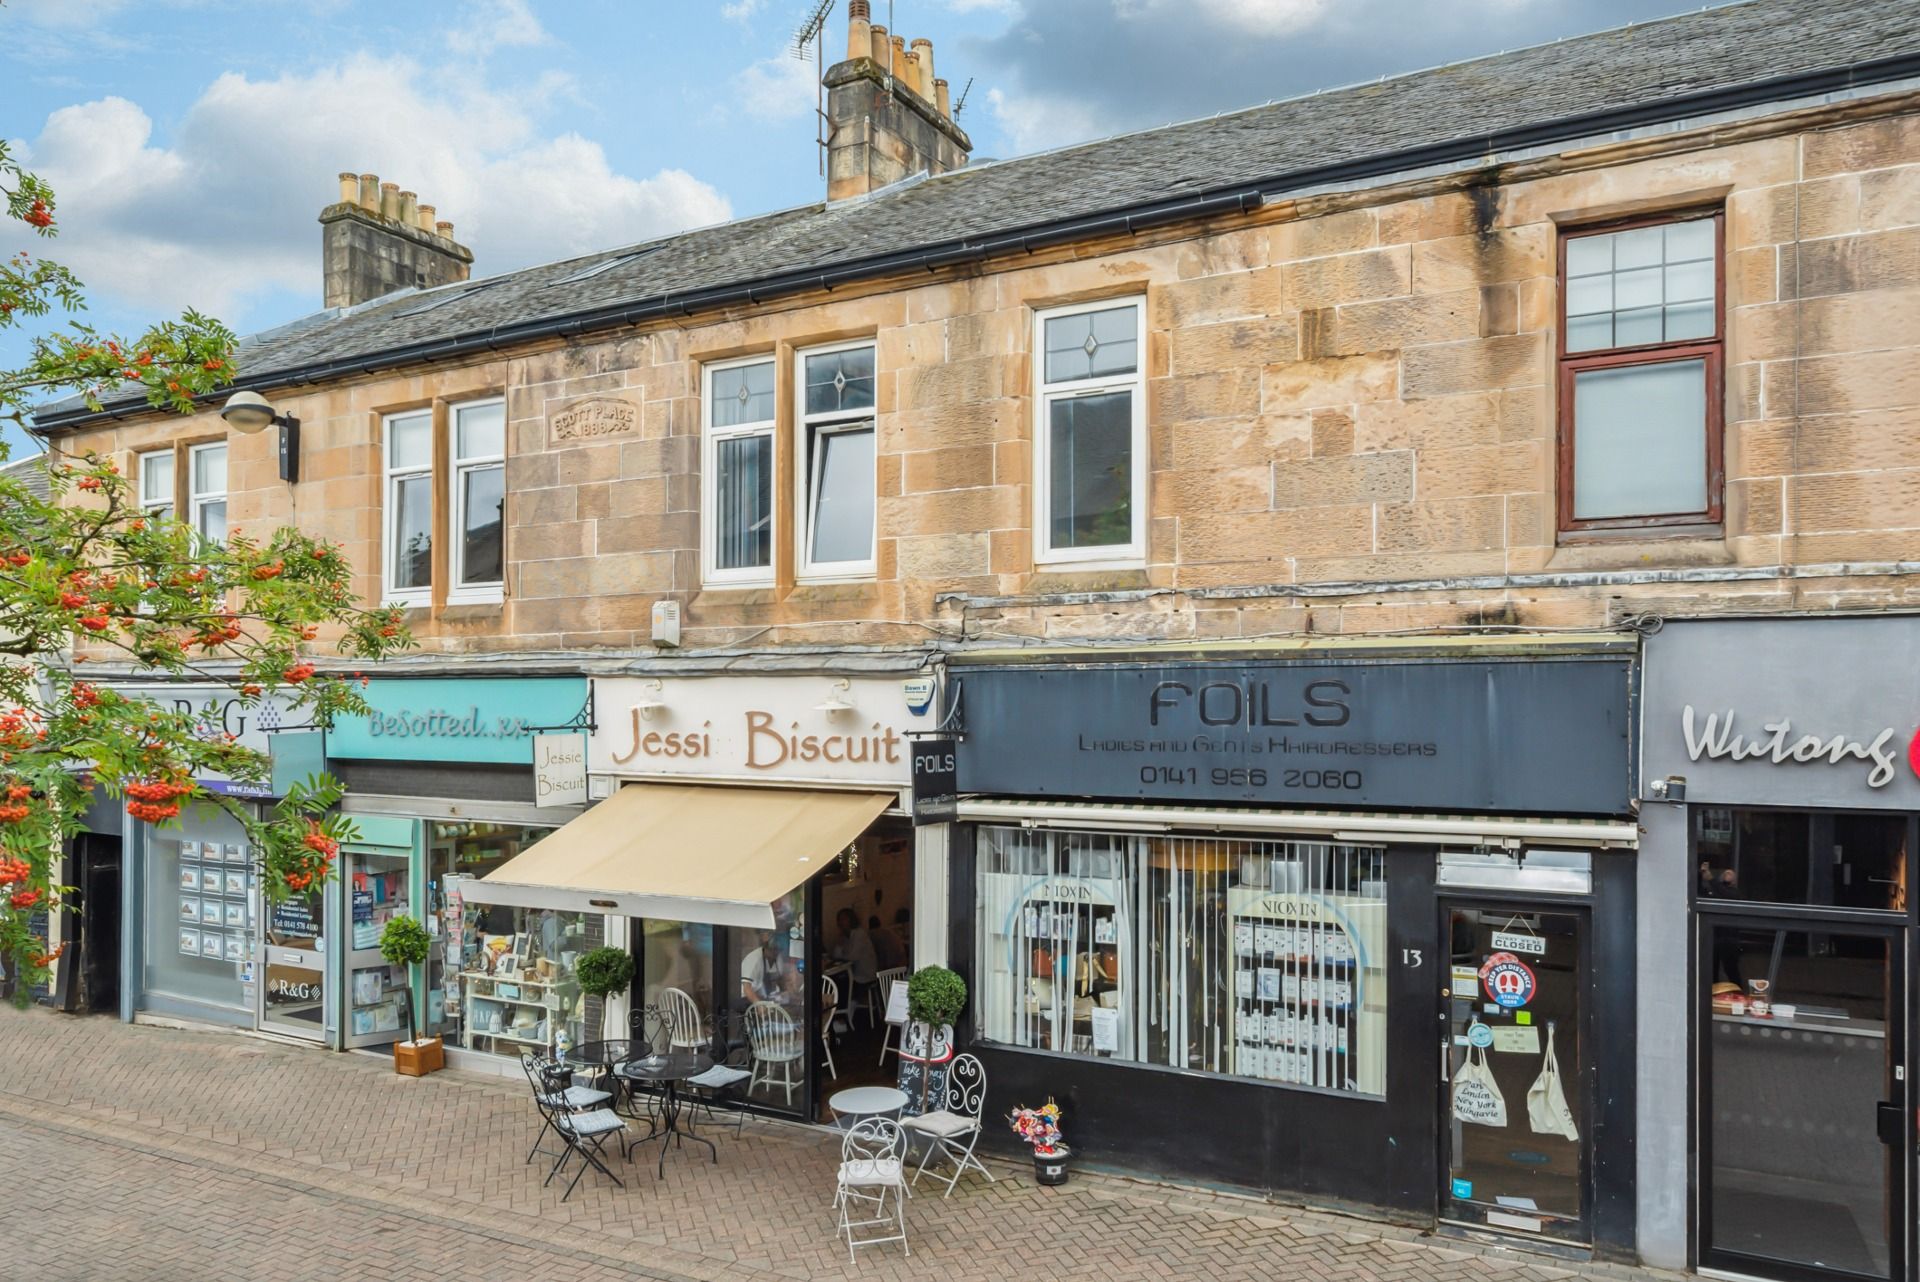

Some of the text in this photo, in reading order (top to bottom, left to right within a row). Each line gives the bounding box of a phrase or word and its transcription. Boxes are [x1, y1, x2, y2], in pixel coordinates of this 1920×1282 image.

[595, 406, 634, 423] PLACE
[1149, 679, 1352, 728] FOILS
[611, 708, 901, 770] Jessi Biscuit
[1682, 704, 1897, 788] Wutong
[539, 746, 582, 769] Jessie
[915, 754, 955, 775] FOILS
[538, 774, 585, 797] Biscuit
[1140, 765, 1197, 785] 0141
[1283, 769, 1363, 790] 2060
[1494, 939, 1542, 952] CLOSED
[1402, 948, 1423, 968] 13
[1508, 964, 1532, 988] DISTANCE
[279, 979, 309, 999] R&G
[1477, 1099, 1497, 1109] York
